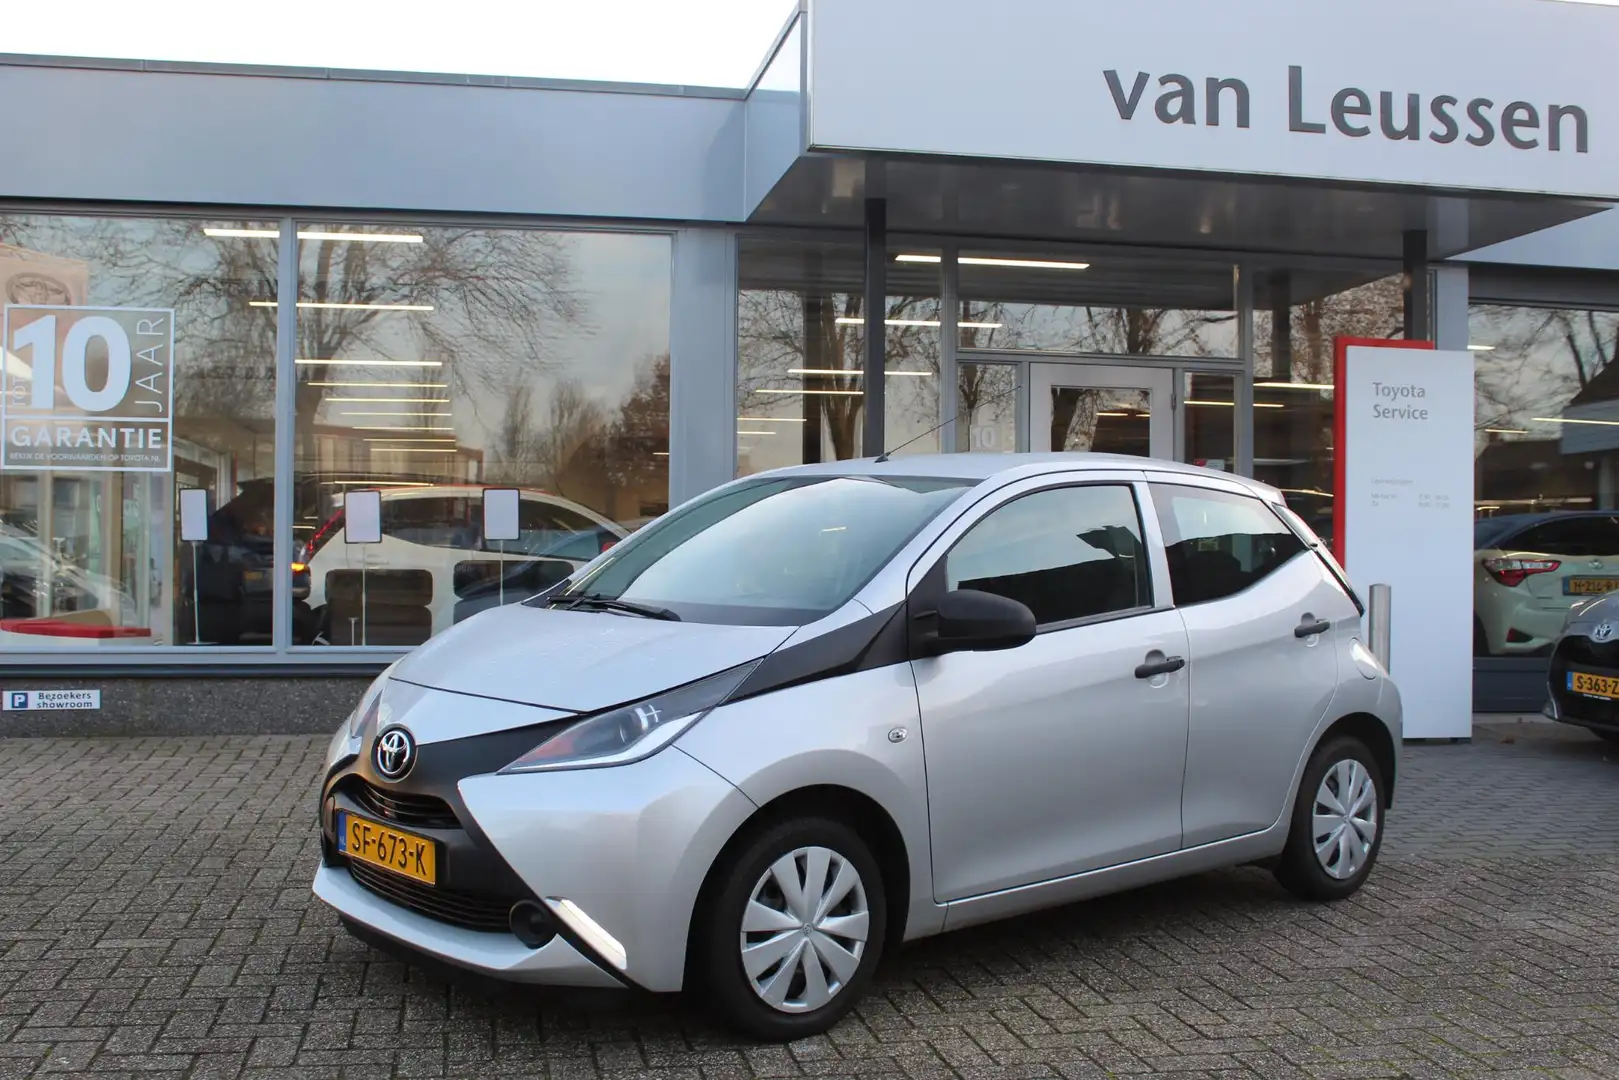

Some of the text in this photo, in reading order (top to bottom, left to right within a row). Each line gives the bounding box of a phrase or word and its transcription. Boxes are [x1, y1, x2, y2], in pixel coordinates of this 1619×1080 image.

[1102, 64, 1589, 154] van Leussen
[13, 314, 133, 412] 10
[134, 317, 164, 413] JAAR
[12, 374, 26, 407] TOT
[1372, 382, 1426, 401] Toyota
[1372, 403, 1429, 420] Service
[11, 425, 163, 449] GARANTIE
[14, 694, 26, 707] P
[37, 700, 93, 709] showroom
[38, 691, 92, 700] Bezoekers
[352, 822, 427, 876] SF-673-K
